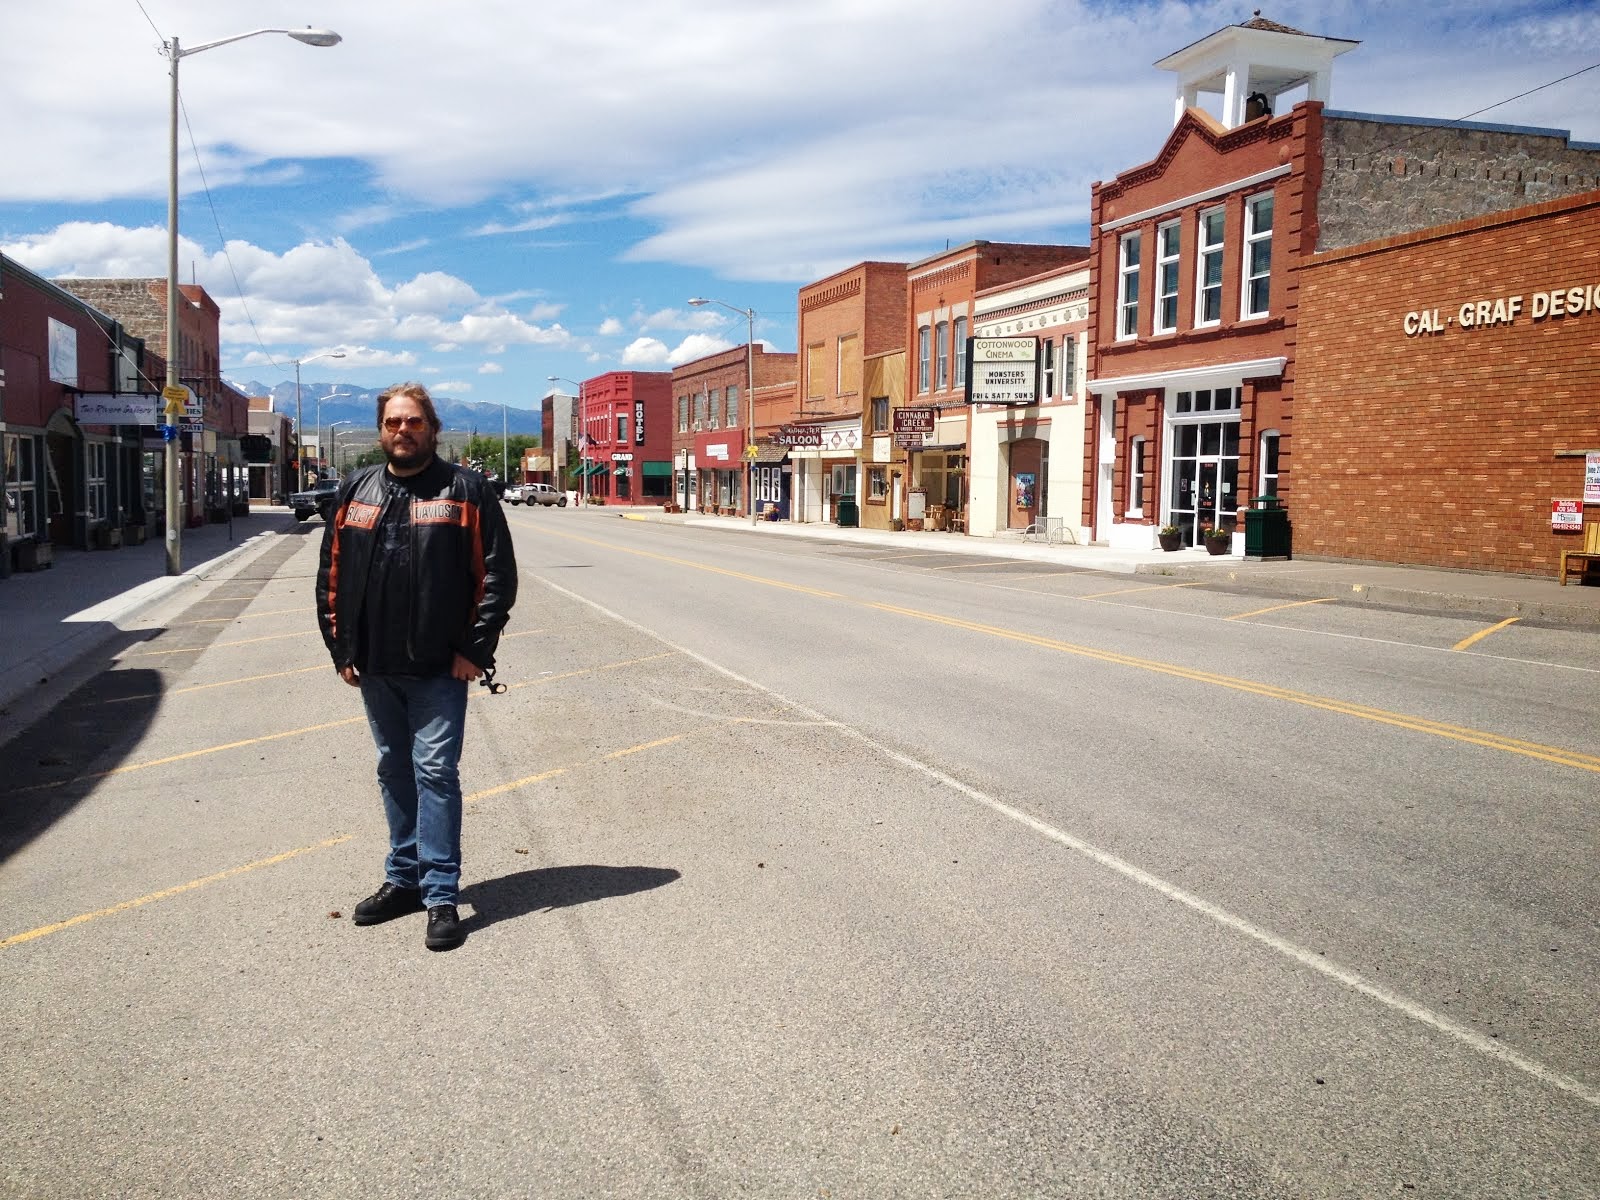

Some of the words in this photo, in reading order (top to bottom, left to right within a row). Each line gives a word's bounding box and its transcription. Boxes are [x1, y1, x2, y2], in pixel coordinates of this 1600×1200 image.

[1404, 309, 1444, 335] CAL
[1459, 296, 1523, 327] GRAF
[976, 340, 1034, 350] COTTONWOOD
[985, 350, 1014, 359] CINEMA
[897, 411, 931, 420] CINNABAR
[635, 403, 644, 442] HOTEL
[902, 419, 926, 427] CREEK
[779, 435, 820, 445] SALOON
[611, 453, 633, 461] GRAND
